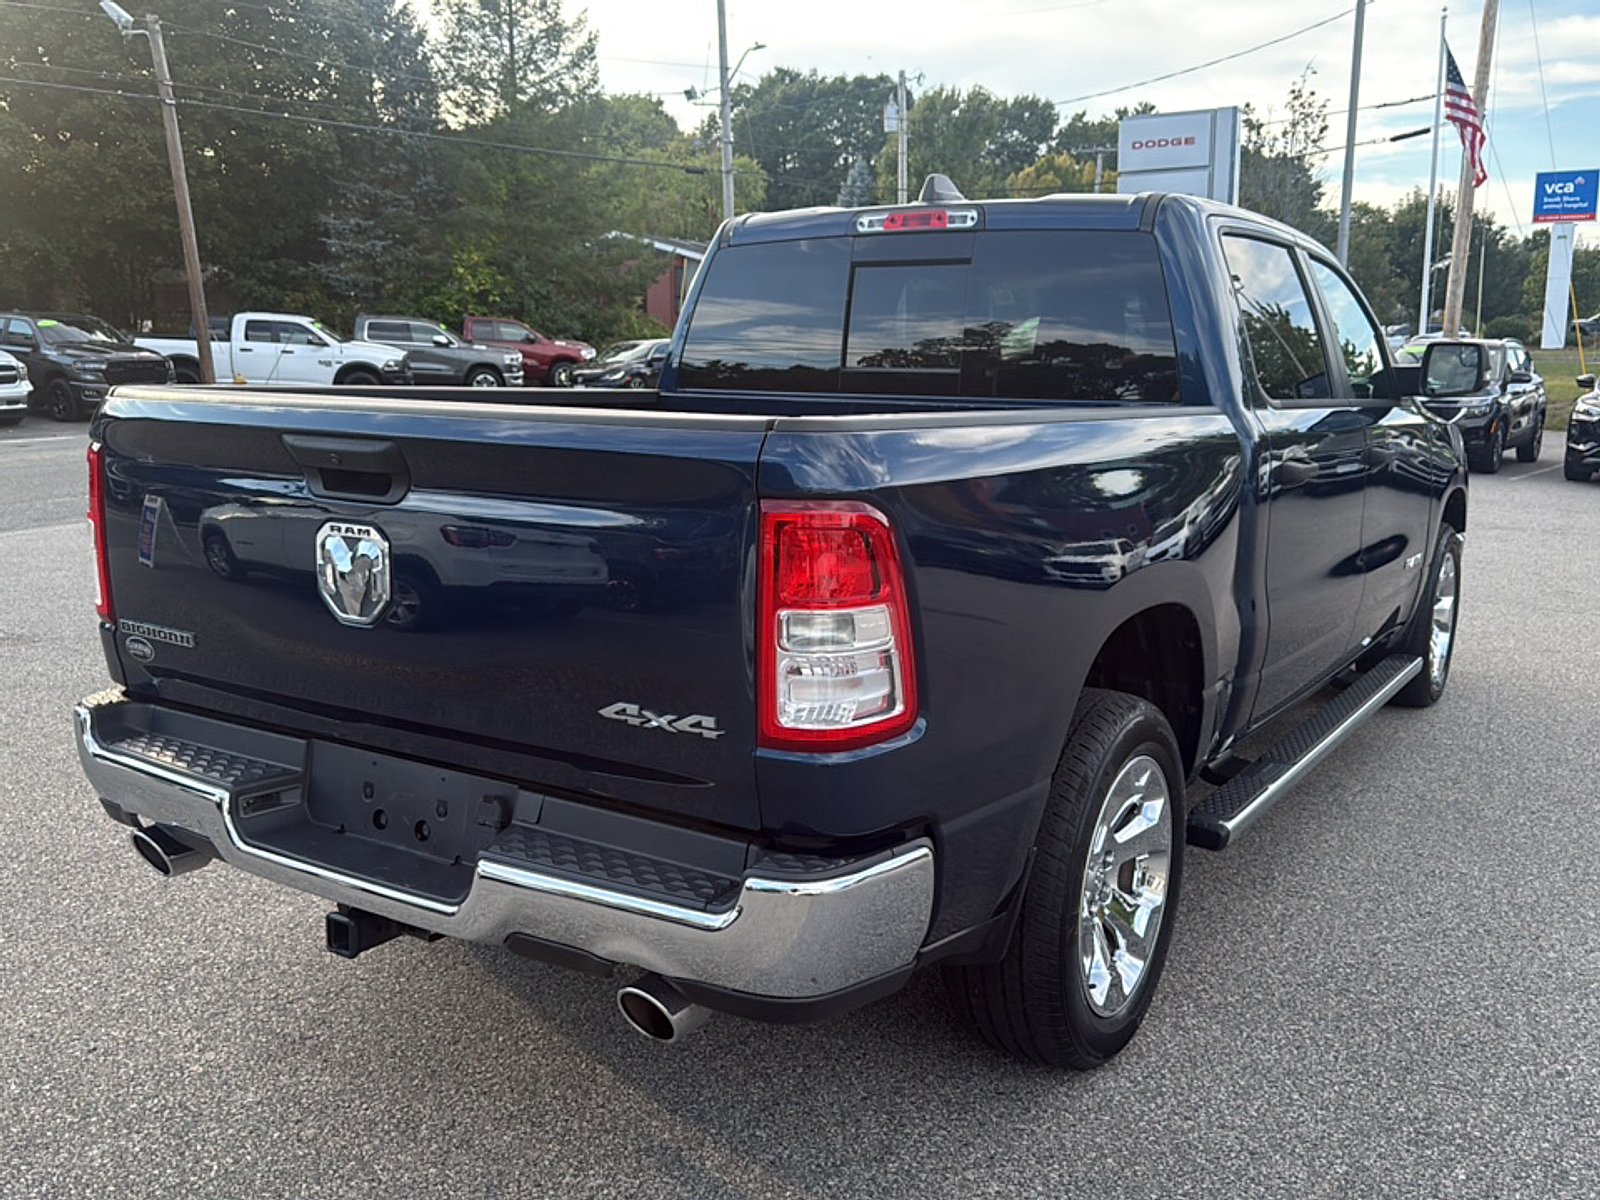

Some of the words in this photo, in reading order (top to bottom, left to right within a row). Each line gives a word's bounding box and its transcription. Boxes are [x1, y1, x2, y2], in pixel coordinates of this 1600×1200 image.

[1132, 137, 1195, 149] DODGE
[1544, 182, 1574, 194] vca
[330, 525, 371, 536] RAM
